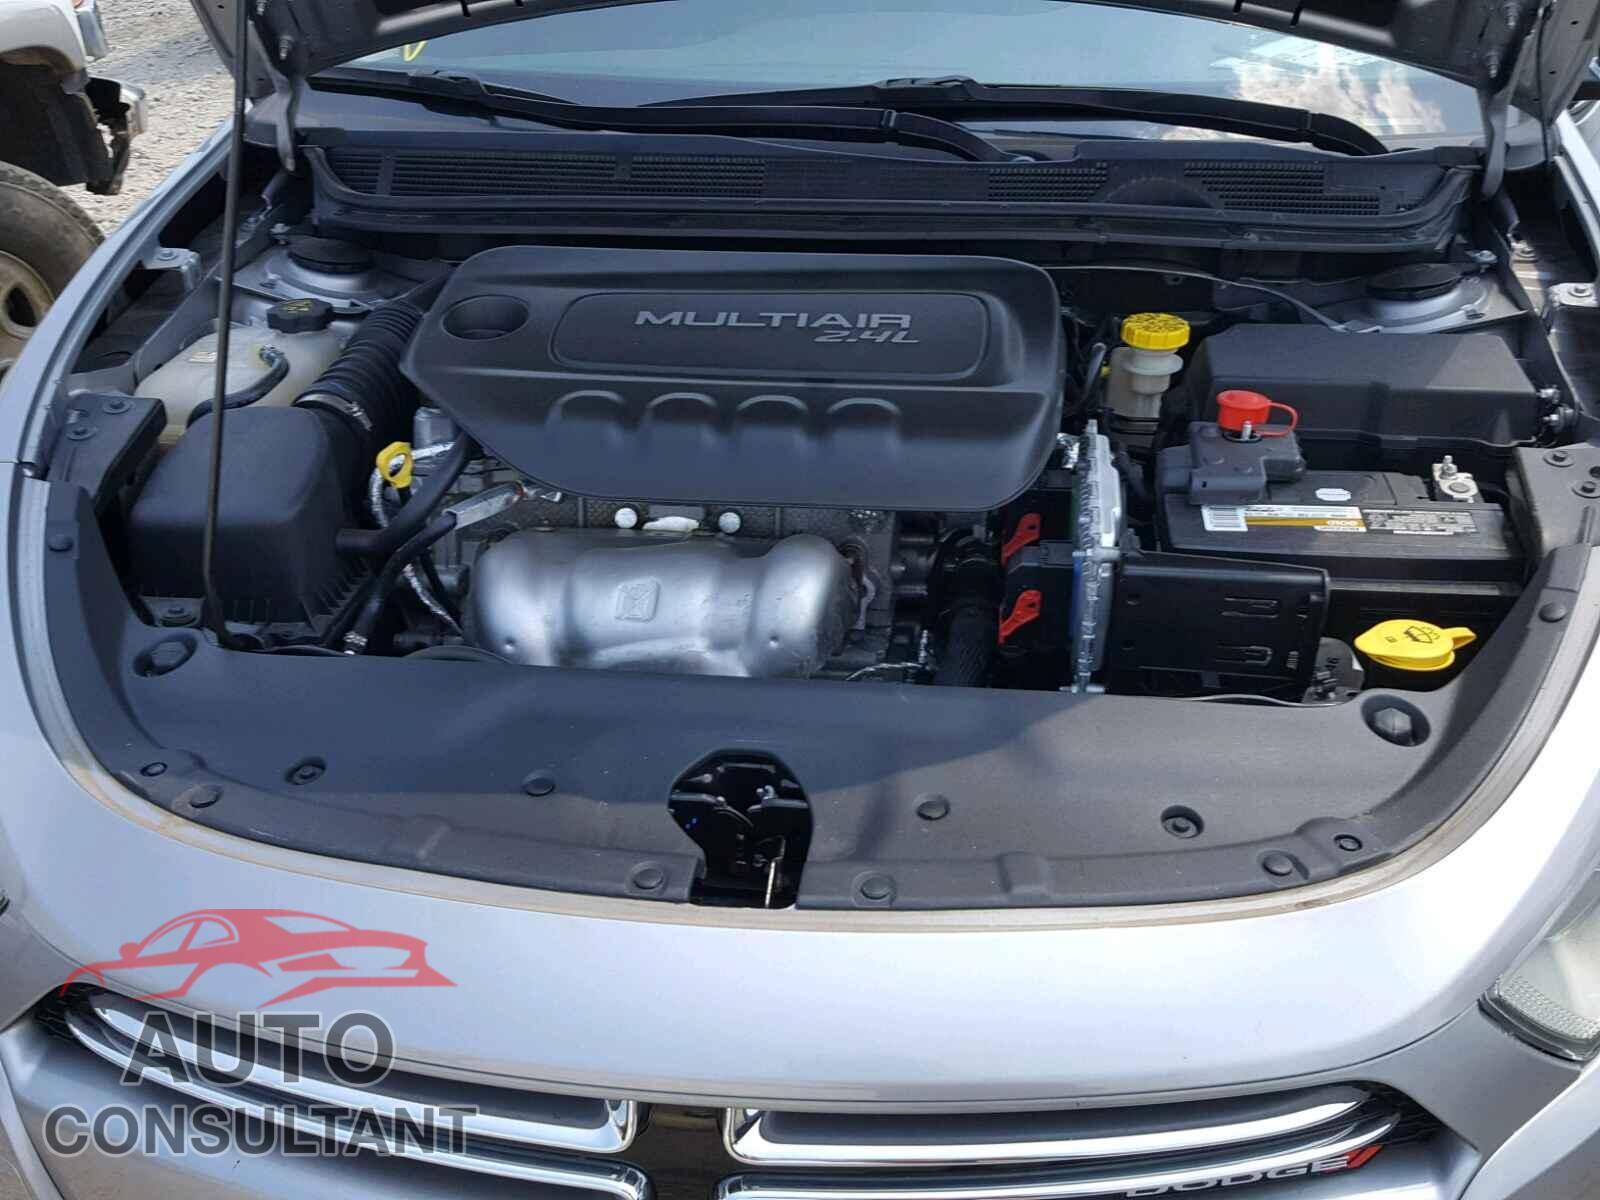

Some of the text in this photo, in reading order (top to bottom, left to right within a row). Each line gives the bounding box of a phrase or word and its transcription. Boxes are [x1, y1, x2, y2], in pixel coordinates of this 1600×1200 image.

[635, 310, 911, 329] MULTIAIR
[813, 329, 920, 343] 2.4L
[1125, 1156, 1349, 1198] DODGE
